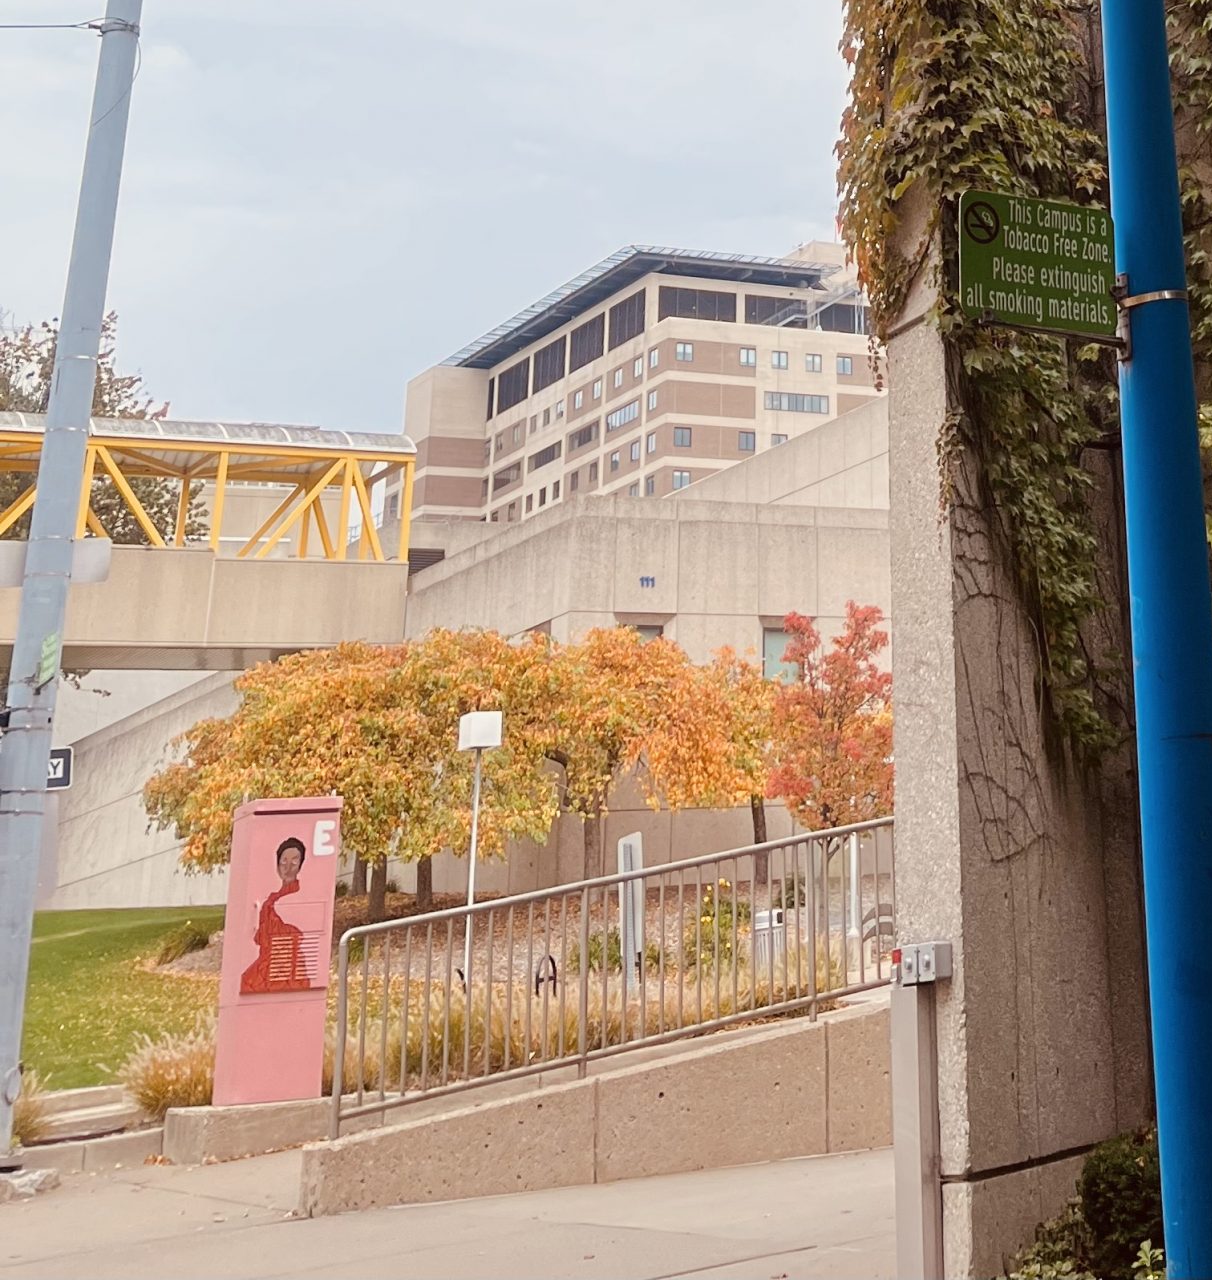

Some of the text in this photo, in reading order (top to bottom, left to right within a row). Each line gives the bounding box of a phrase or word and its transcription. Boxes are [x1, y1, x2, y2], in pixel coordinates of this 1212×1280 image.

[1008, 200, 1107, 237] This Campus is a
[1003, 225, 1112, 264] Tobacco Free Zone.
[992, 256, 1106, 298] Please extinguish
[966, 282, 1112, 326] all smoking materials.
[639, 576, 655, 589] 111
